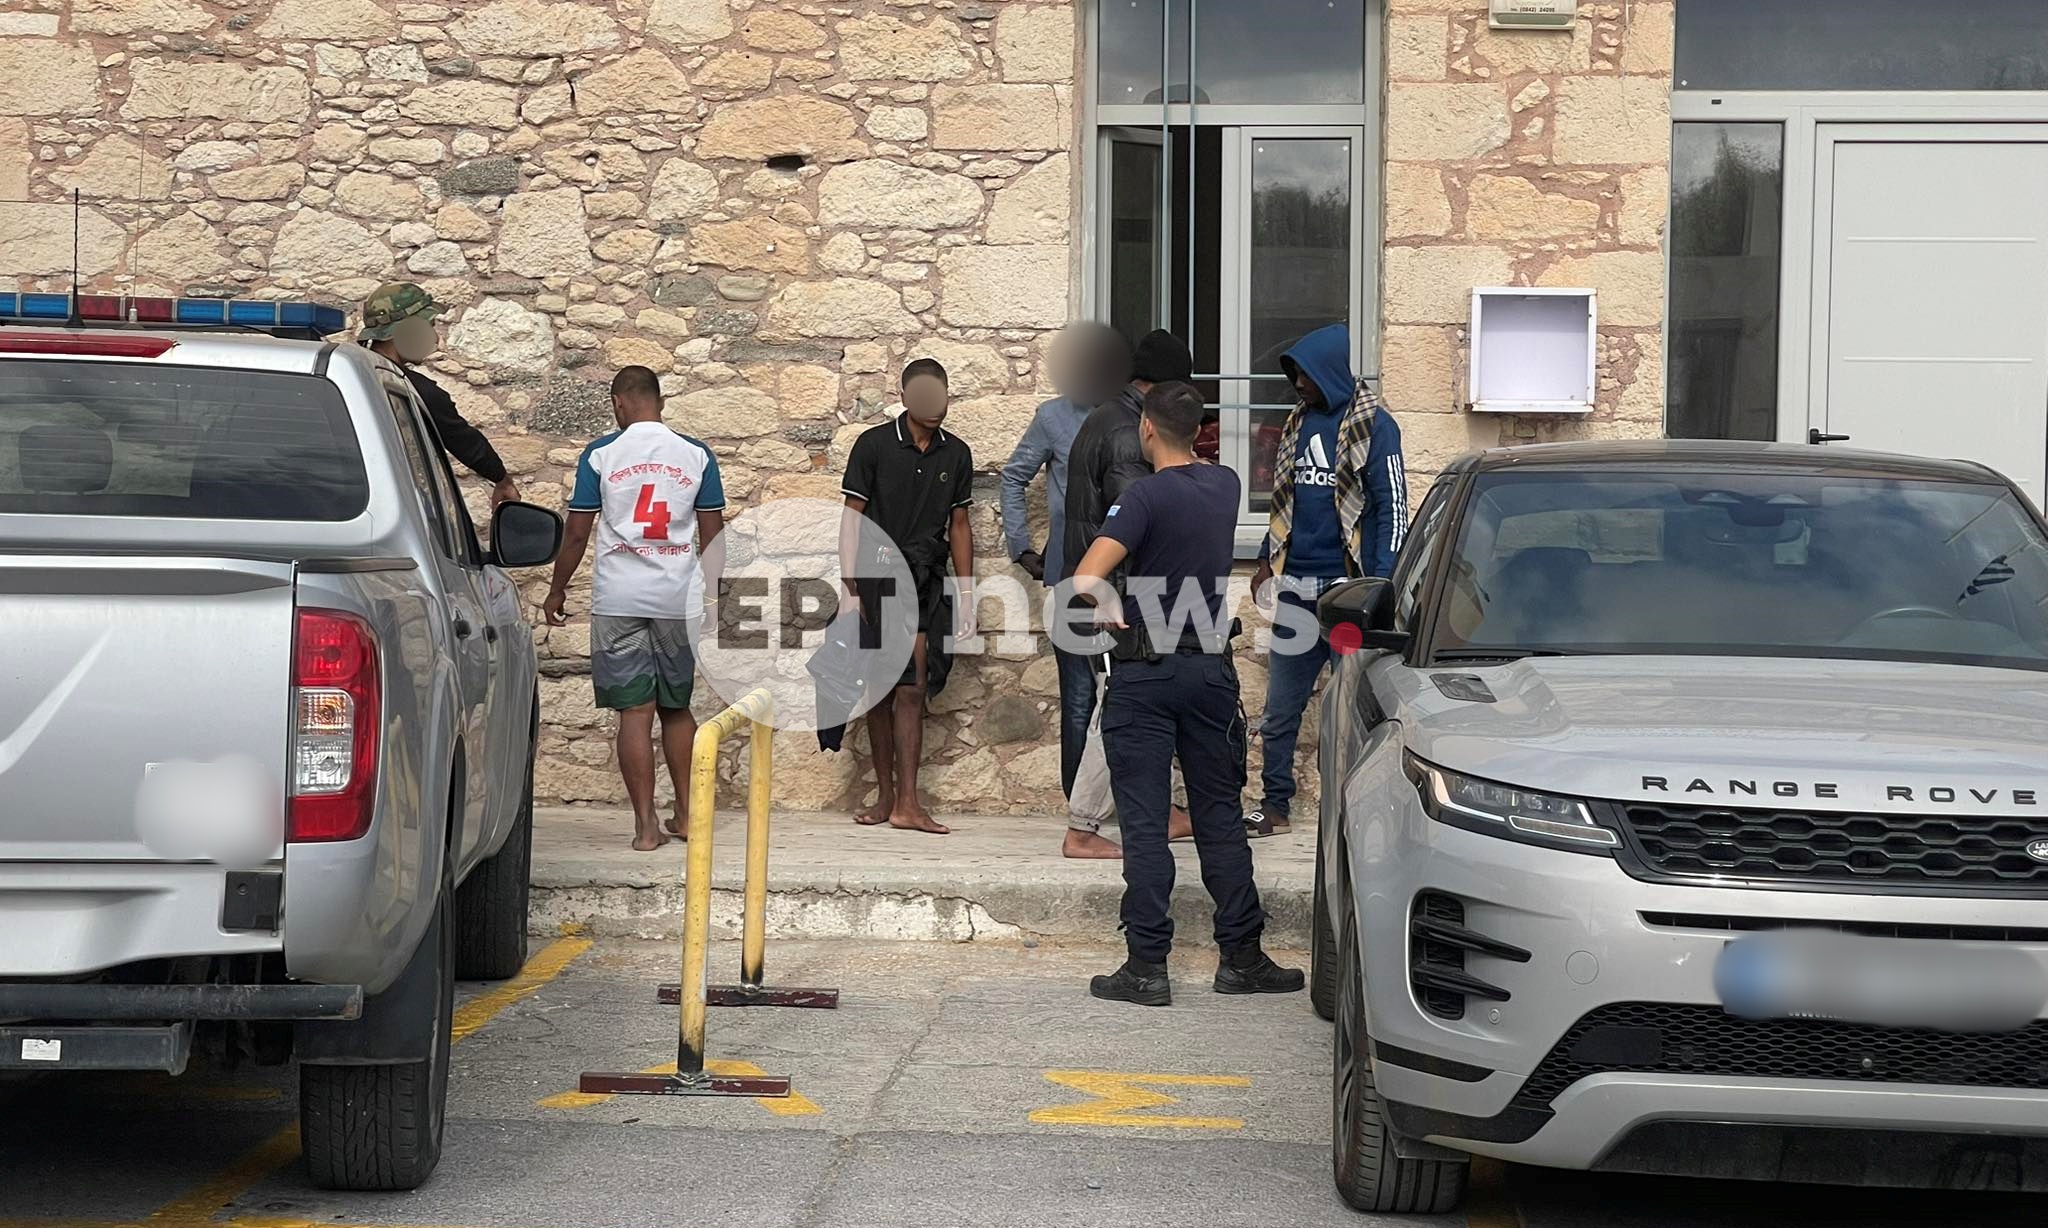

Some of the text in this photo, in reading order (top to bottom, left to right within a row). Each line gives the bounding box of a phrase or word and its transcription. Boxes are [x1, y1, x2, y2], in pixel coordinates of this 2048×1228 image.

[633, 484, 671, 540] 4
[1641, 775, 2036, 804] RANGE ROVE
